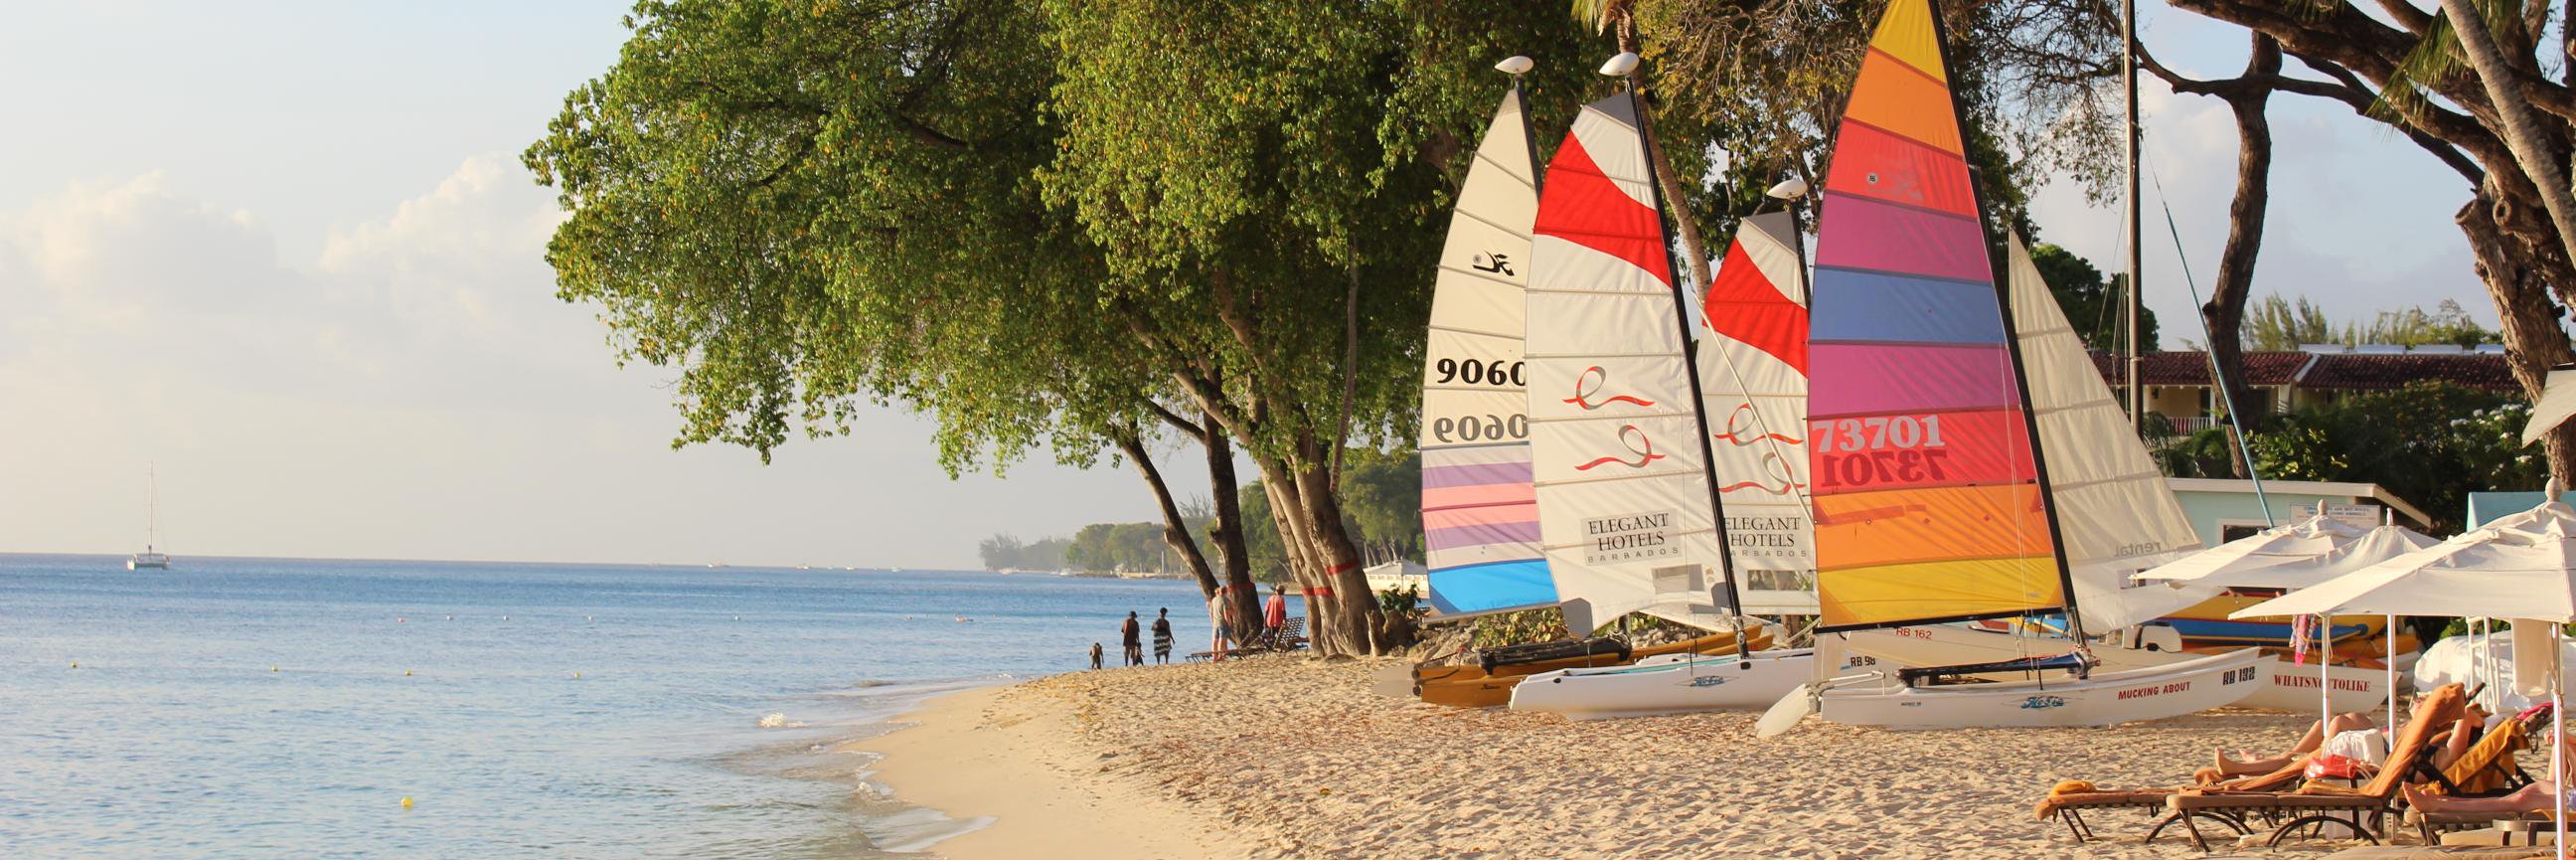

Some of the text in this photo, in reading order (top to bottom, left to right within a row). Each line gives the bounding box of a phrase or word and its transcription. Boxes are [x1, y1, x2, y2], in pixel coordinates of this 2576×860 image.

[1812, 414, 1946, 453] 73701
[1588, 512, 1670, 535] ELEGANT
[1724, 516, 1801, 531] ELEGANT
[1598, 530, 1666, 552] HOTELS
[1730, 533, 1795, 548] HOTELS
[1587, 547, 1679, 564] BARBADOS
[1730, 549, 1807, 558] ARBADOS
[1895, 627, 1932, 640] RB 162
[1850, 656, 1862, 667] RB
[2222, 665, 2256, 686] RB 132
[2118, 681, 2191, 700] MUCKING ABOUT
